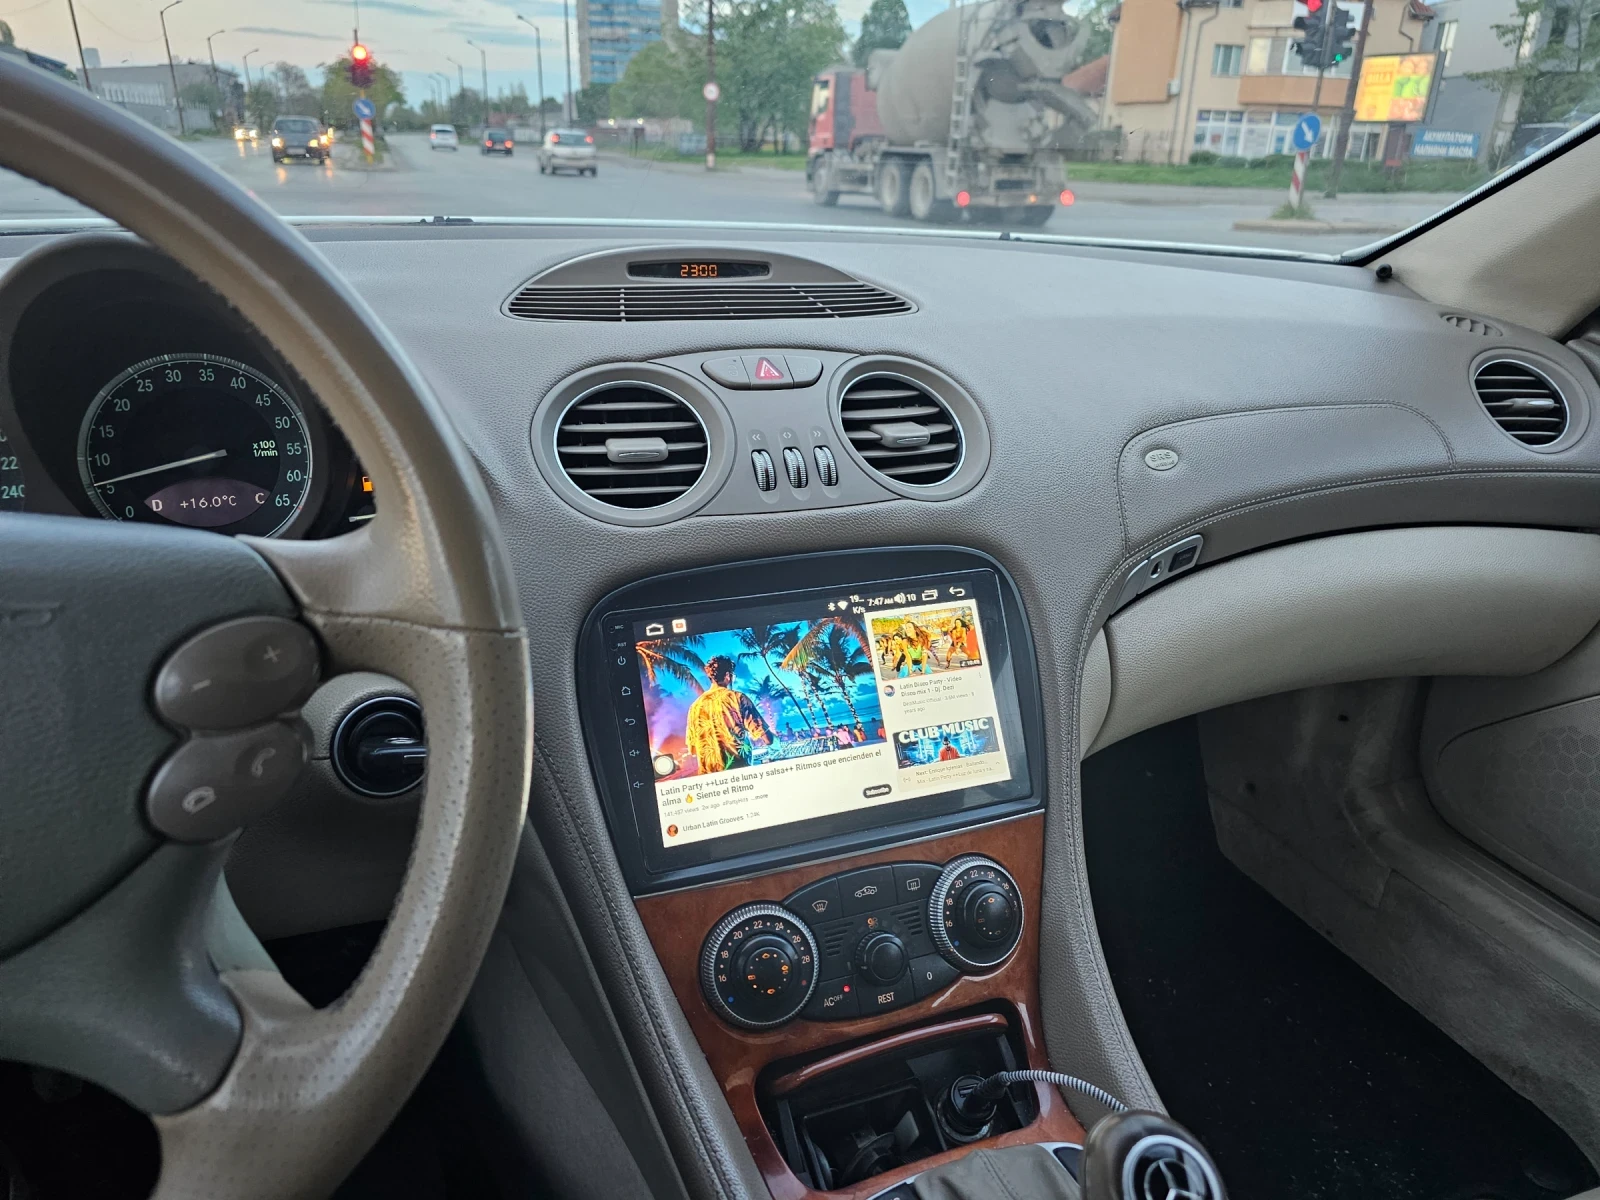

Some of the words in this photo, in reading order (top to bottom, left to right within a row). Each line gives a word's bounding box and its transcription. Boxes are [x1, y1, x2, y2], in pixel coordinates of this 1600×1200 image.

[165, 369, 182, 382] 30
[199, 369, 215, 381] 35
[136, 379, 154, 392] 25
[230, 376, 247, 389] 40
[113, 398, 131, 411] 20
[255, 393, 271, 406] 45
[275, 416, 290, 429] 50
[99, 424, 115, 438] 15
[253, 449, 278, 457] 1/min
[286, 442, 302, 455] 55
[94, 453, 110, 466] 10
[1150, 451, 1172, 462] SRS
[286, 469, 301, 482] 60
[1, 484, 25, 499] 240
[106, 484, 115, 494] 5
[179, 494, 237, 509] +16.0°C
[254, 491, 265, 505] C
[275, 493, 290, 507] 65
[125, 505, 134, 518] 0
[151, 499, 163, 512] D
[906, 593, 917, 602] 10
[852, 606, 866, 614] K/s
[900, 681, 914, 690] Latin
[929, 679, 943, 688] Party
[898, 725, 940, 744] CLUB
[941, 717, 990, 736] MUSIC
[660, 786, 681, 797] Latin
[682, 782, 704, 793] Party
[705, 777, 729, 788] ++Luz
[730, 775, 740, 783] de
[741, 772, 758, 782] luna
[759, 772, 764, 780] y
[766, 765, 794, 777] salsa++
[795, 761, 822, 772] Ritmos
[823, 758, 837, 768] que
[838, 751, 874, 763] encienden
[875, 749, 882, 757] el
[662, 798, 682, 807] alma
[696, 788, 721, 800] Siente
[722, 786, 730, 795] el
[731, 783, 754, 793] Ritmo
[684, 806, 700, 814] views
[710, 802, 720, 811] ago
[682, 822, 701, 832] Urban
[702, 819, 718, 828] Latin
[719, 814, 744, 825] Grooves
[969, 870, 979, 878] 22
[954, 880, 964, 888] 20
[945, 898, 954, 906] 18
[753, 920, 763, 929] 22
[774, 922, 785, 931] 24
[732, 930, 743, 939] 20
[792, 935, 801, 943] 26
[720, 950, 729, 959] 18
[801, 955, 811, 964] 28
[718, 974, 727, 982] 16
[877, 991, 895, 1005] REST
